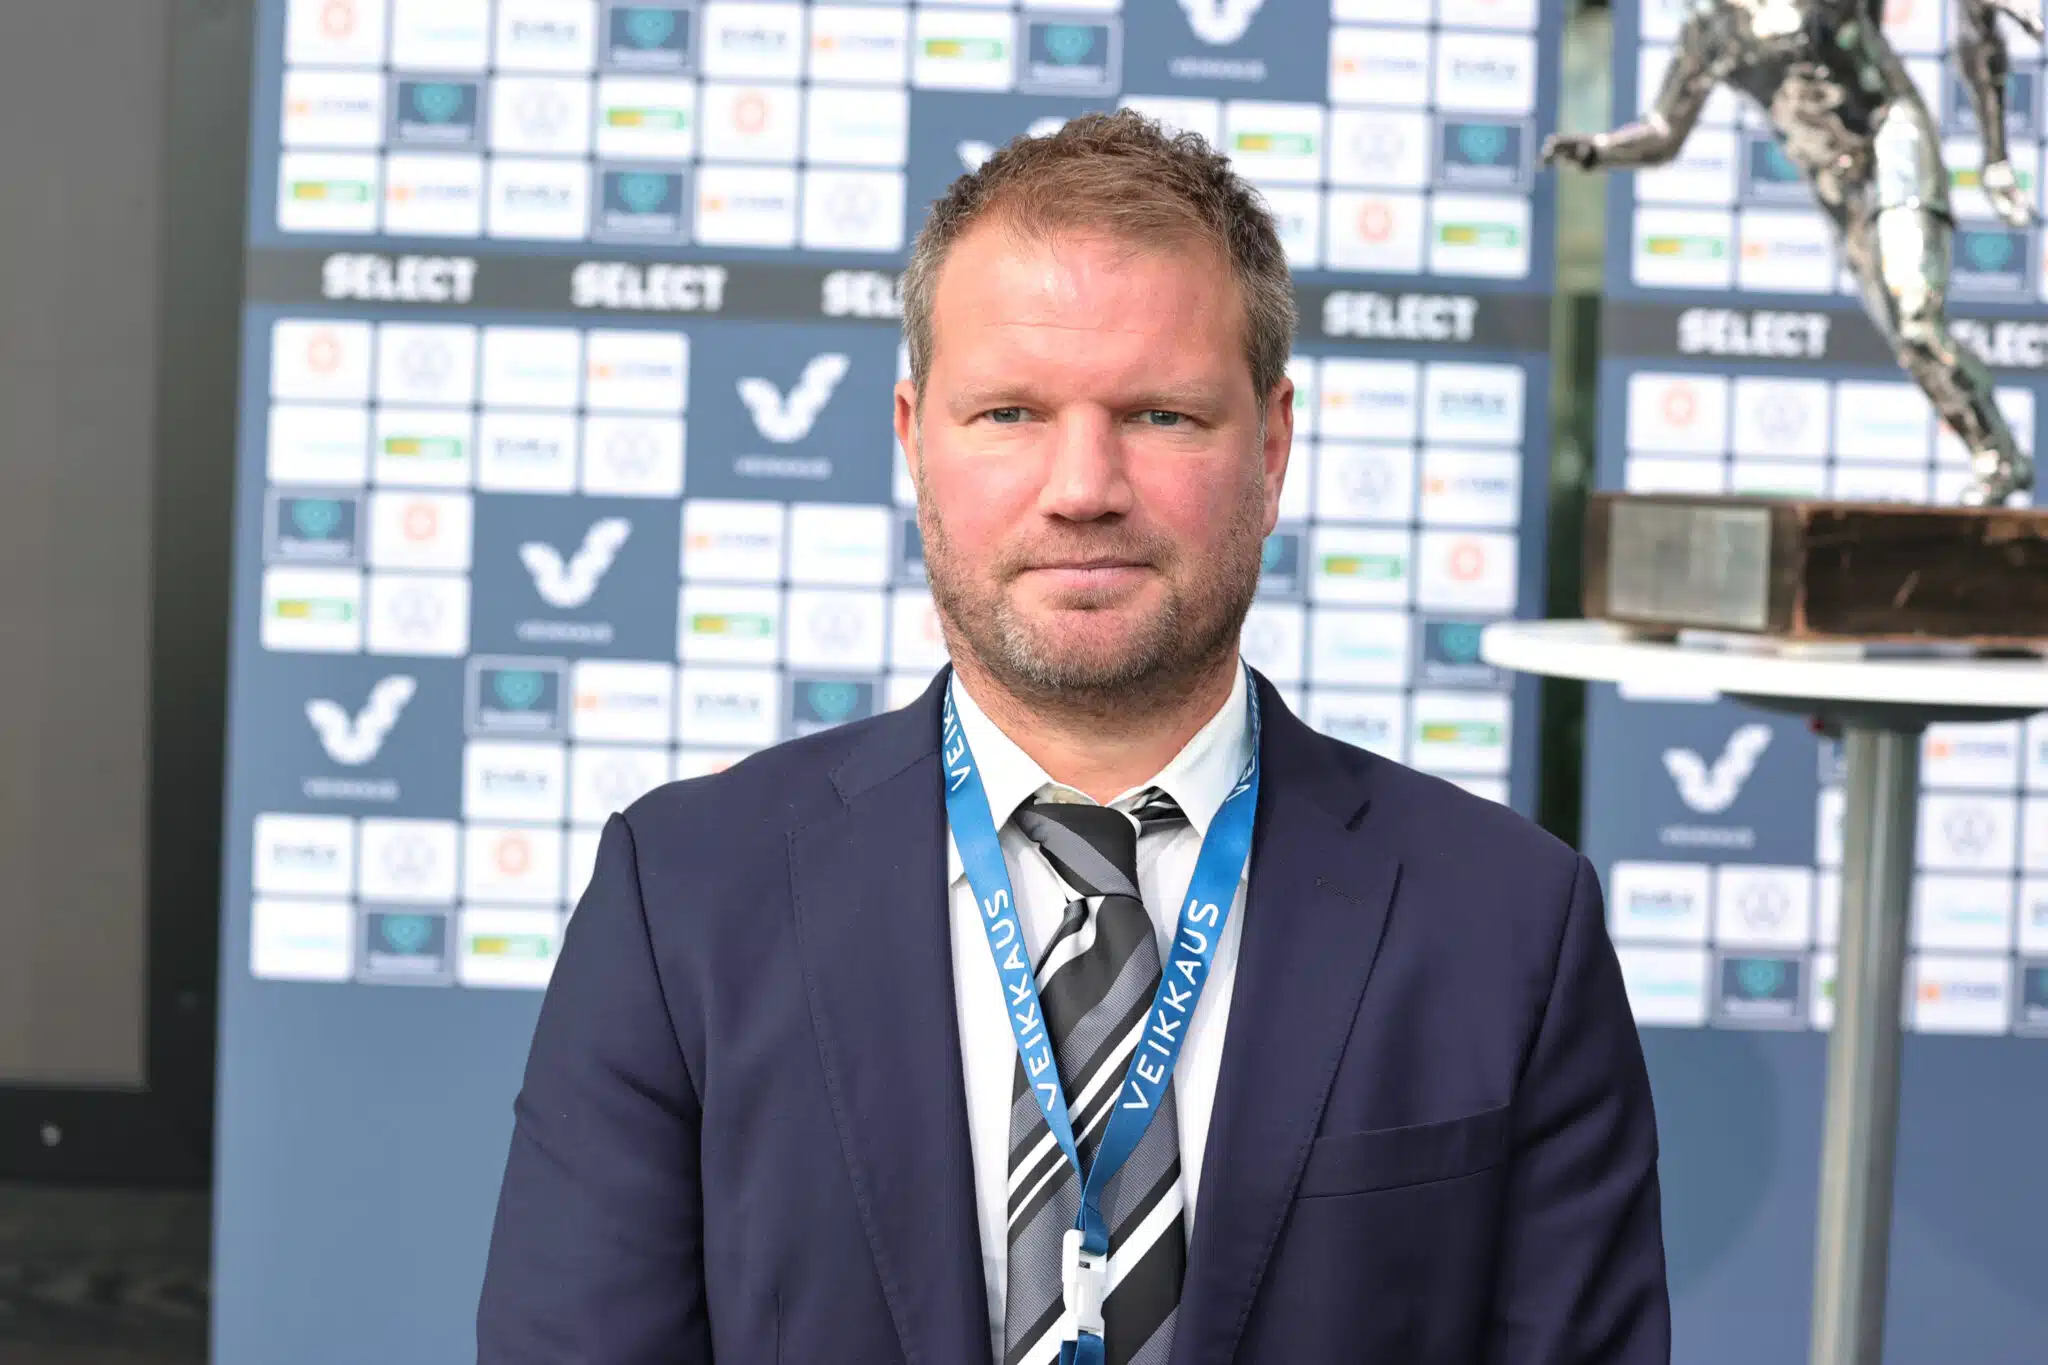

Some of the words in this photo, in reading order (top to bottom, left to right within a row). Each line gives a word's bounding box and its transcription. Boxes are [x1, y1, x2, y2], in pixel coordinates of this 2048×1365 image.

[322, 252, 478, 303] SELECT
[571, 260, 727, 312] SELECT
[1322, 290, 1479, 342] SELECT
[1677, 308, 1831, 359] SELECT
[984, 888, 1057, 1112] VEIKKAUS
[1122, 899, 1220, 1110] VEIKKAUS
